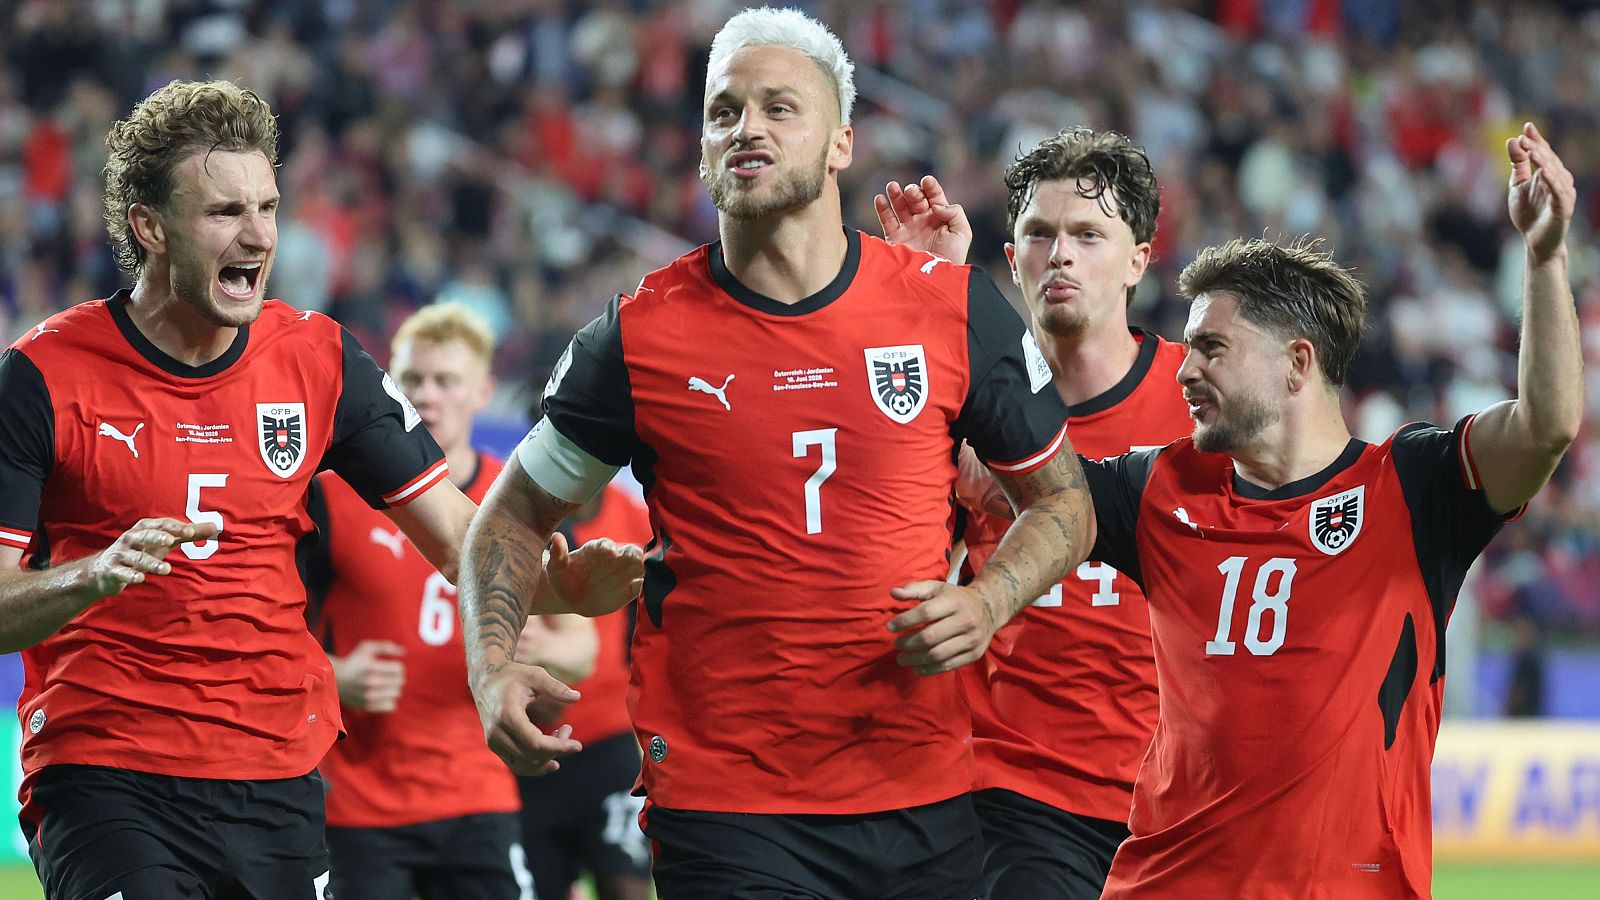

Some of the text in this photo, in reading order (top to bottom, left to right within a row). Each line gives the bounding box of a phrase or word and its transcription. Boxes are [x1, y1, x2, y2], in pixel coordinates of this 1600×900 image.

[180, 473, 230, 560] 5
[792, 427, 838, 535] 7
[418, 571, 457, 646] 6
[1205, 556, 1298, 656] 18
